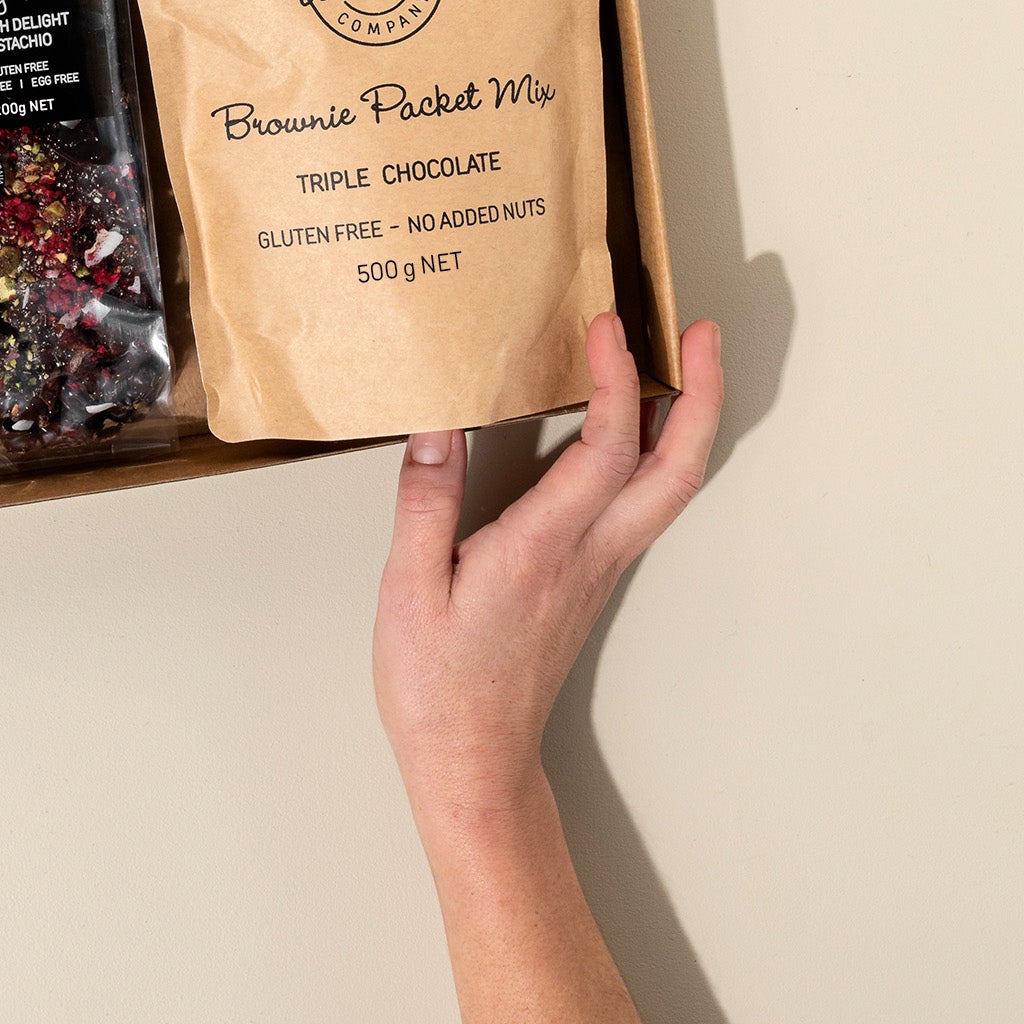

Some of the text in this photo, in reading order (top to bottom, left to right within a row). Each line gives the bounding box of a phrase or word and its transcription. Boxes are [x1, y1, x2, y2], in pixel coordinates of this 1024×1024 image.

[12, 12, 69, 33] DELIGHT
[24, 61, 49, 73] FREE
[31, 75, 52, 87] EGG
[54, 72, 79, 84] FREE
[29, 99, 54, 112] NET
[211, 74, 556, 140] Brownie Packet Mix
[296, 151, 501, 194] TRIPLE CHOCOLATE
[258, 226, 330, 249] GLUTEN
[335, 220, 383, 241] FREE
[408, 215, 436, 234] NO
[440, 205, 500, 230] ADDED
[503, 198, 546, 220] NUTS
[421, 251, 462, 273] NET
